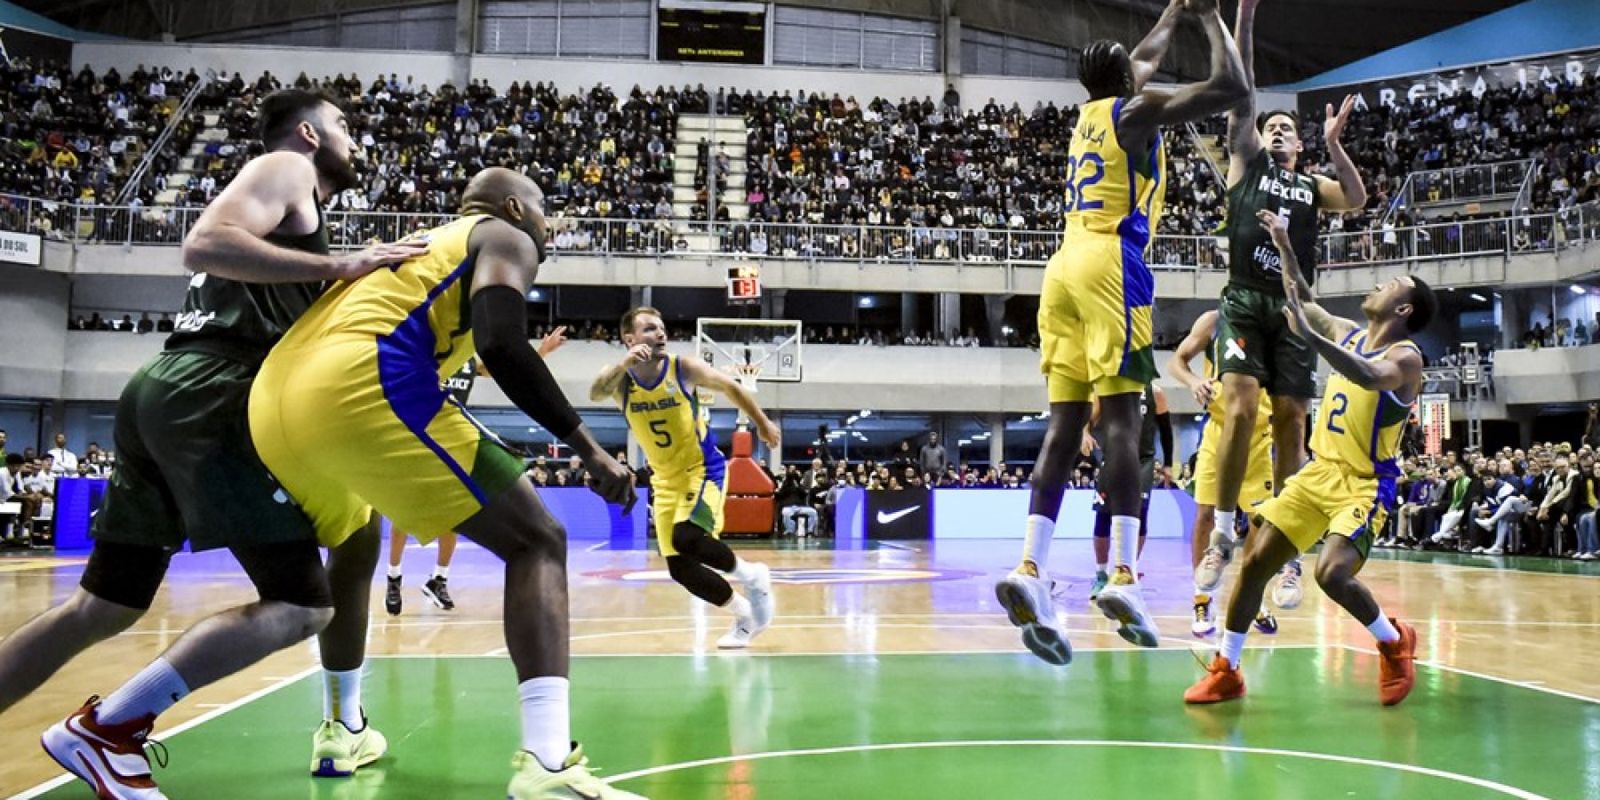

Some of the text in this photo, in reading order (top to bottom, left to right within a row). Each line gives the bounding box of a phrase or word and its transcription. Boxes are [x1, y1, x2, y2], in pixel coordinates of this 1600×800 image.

[630, 397, 681, 413] BRASIL
[1327, 391, 1348, 434] 2
[649, 418, 672, 448] 5
